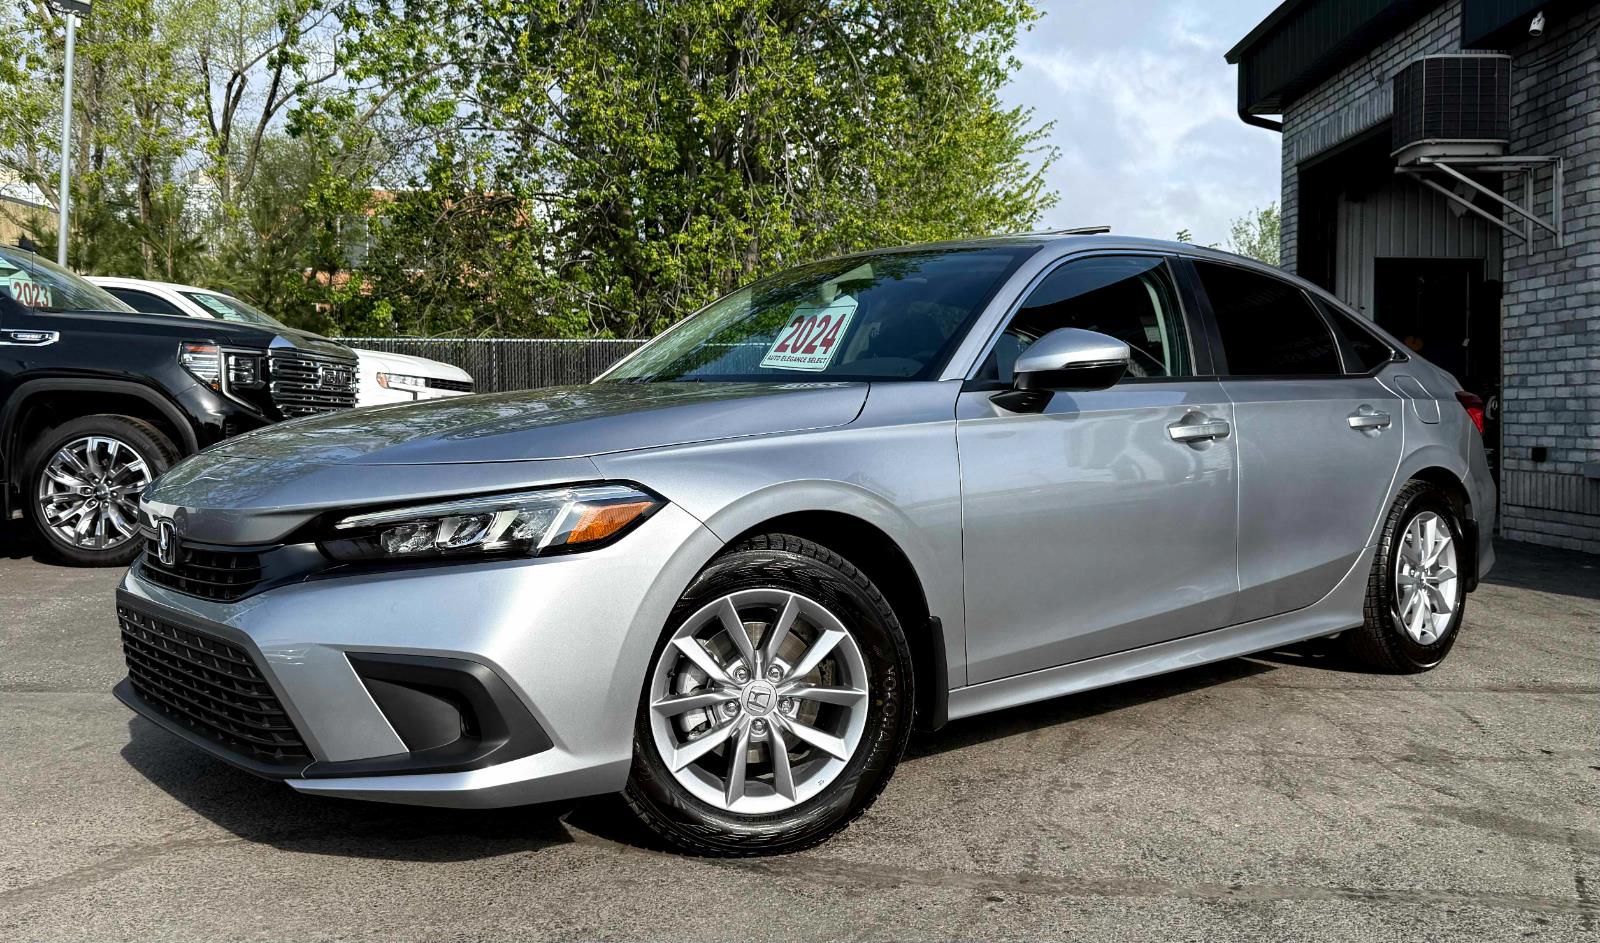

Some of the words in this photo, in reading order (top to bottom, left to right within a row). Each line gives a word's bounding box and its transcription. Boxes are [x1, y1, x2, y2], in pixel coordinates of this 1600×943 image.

[14, 281, 49, 308] 2023
[774, 313, 846, 355] 2024
[781, 355, 807, 363] ELEGANCE
[807, 356, 828, 364] SELECT
[866, 665, 897, 763] YOKOHA
